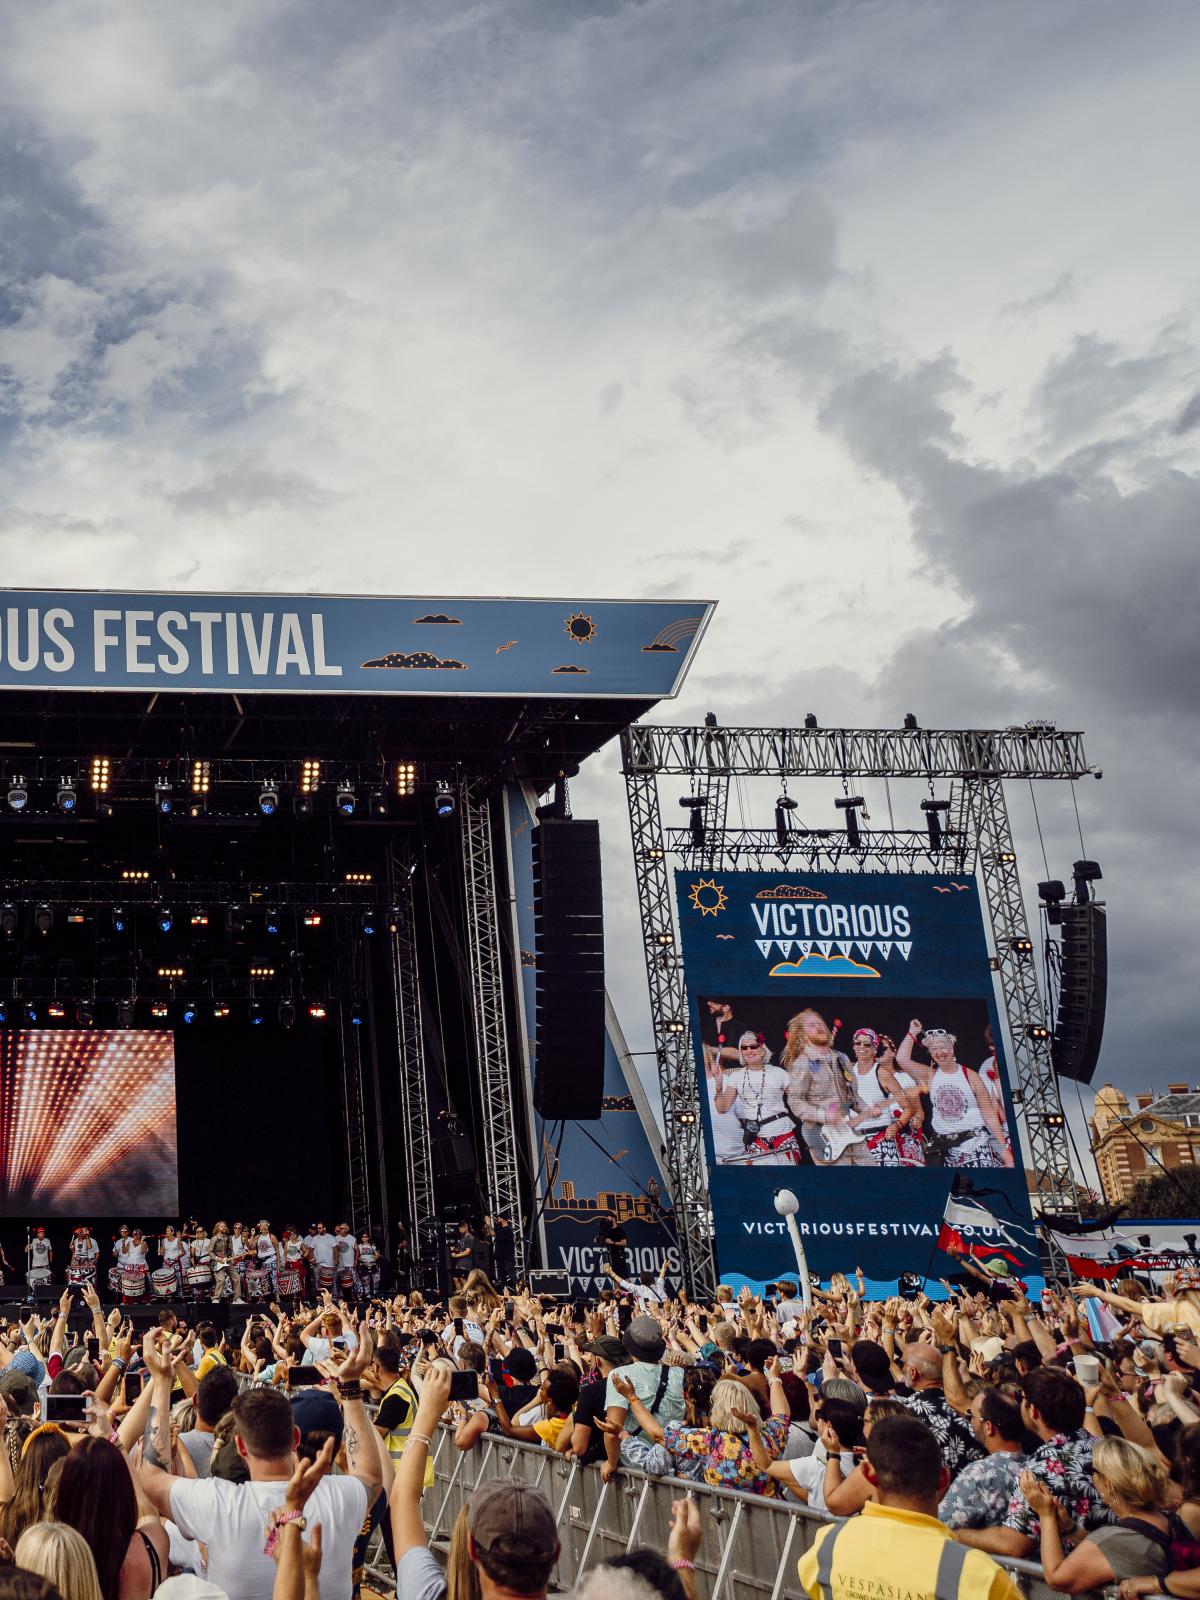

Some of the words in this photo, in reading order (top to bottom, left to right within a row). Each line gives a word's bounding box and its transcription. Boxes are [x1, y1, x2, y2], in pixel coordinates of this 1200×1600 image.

[93, 609, 343, 676] FESTIVAL
[751, 903, 912, 937] VICTORIOUS
[760, 941, 910, 956] FESTIVAL
[559, 1246, 680, 1274] VICTRIOUS
[838, 1573, 928, 1600] VESPASIAN
